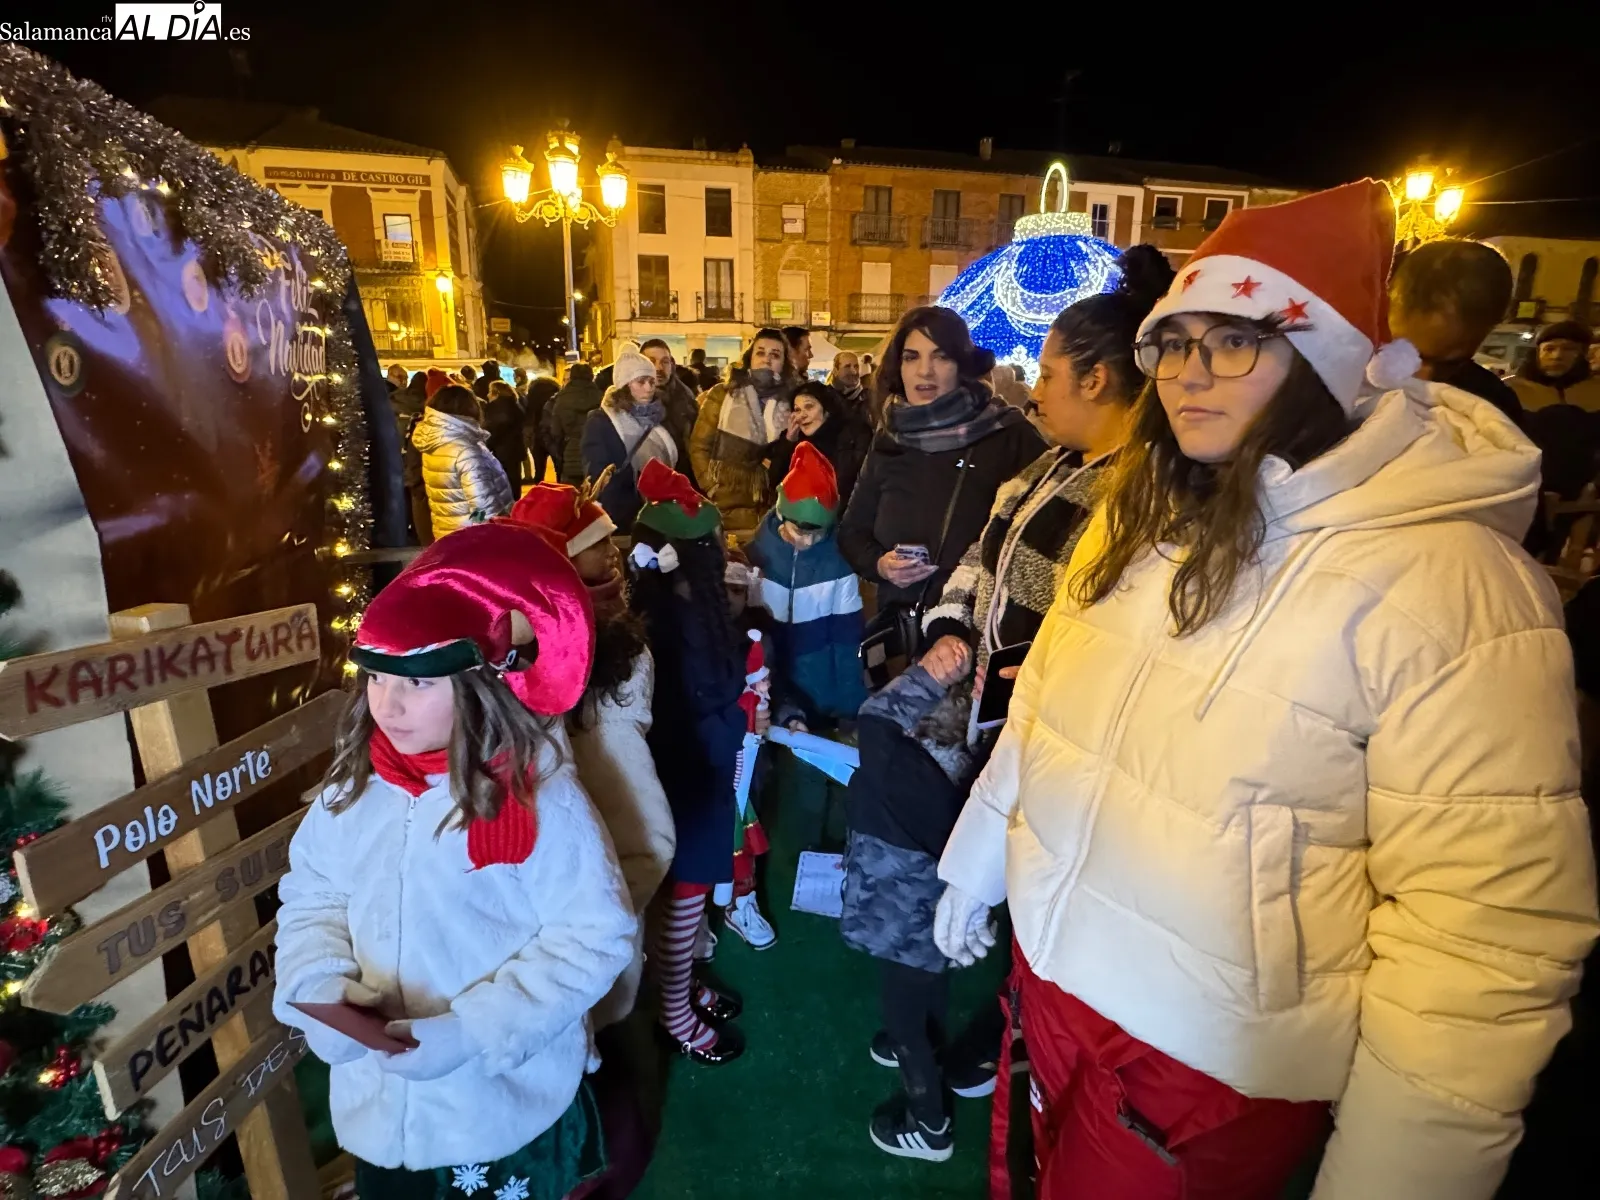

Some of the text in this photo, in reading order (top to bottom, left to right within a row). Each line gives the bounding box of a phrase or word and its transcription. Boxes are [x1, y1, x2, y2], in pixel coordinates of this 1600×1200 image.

[342, 171, 358, 182] DE
[360, 172, 404, 184] CASTRO
[407, 174, 426, 186] GIL
[268, 246, 320, 320] Feliz
[257, 298, 326, 388] Navidad
[24, 615, 317, 715] KARIKATURA
[93, 749, 272, 869] Polo Norte
[97, 838, 289, 976] TUS SUE
[241, 1026, 307, 1098] DES
